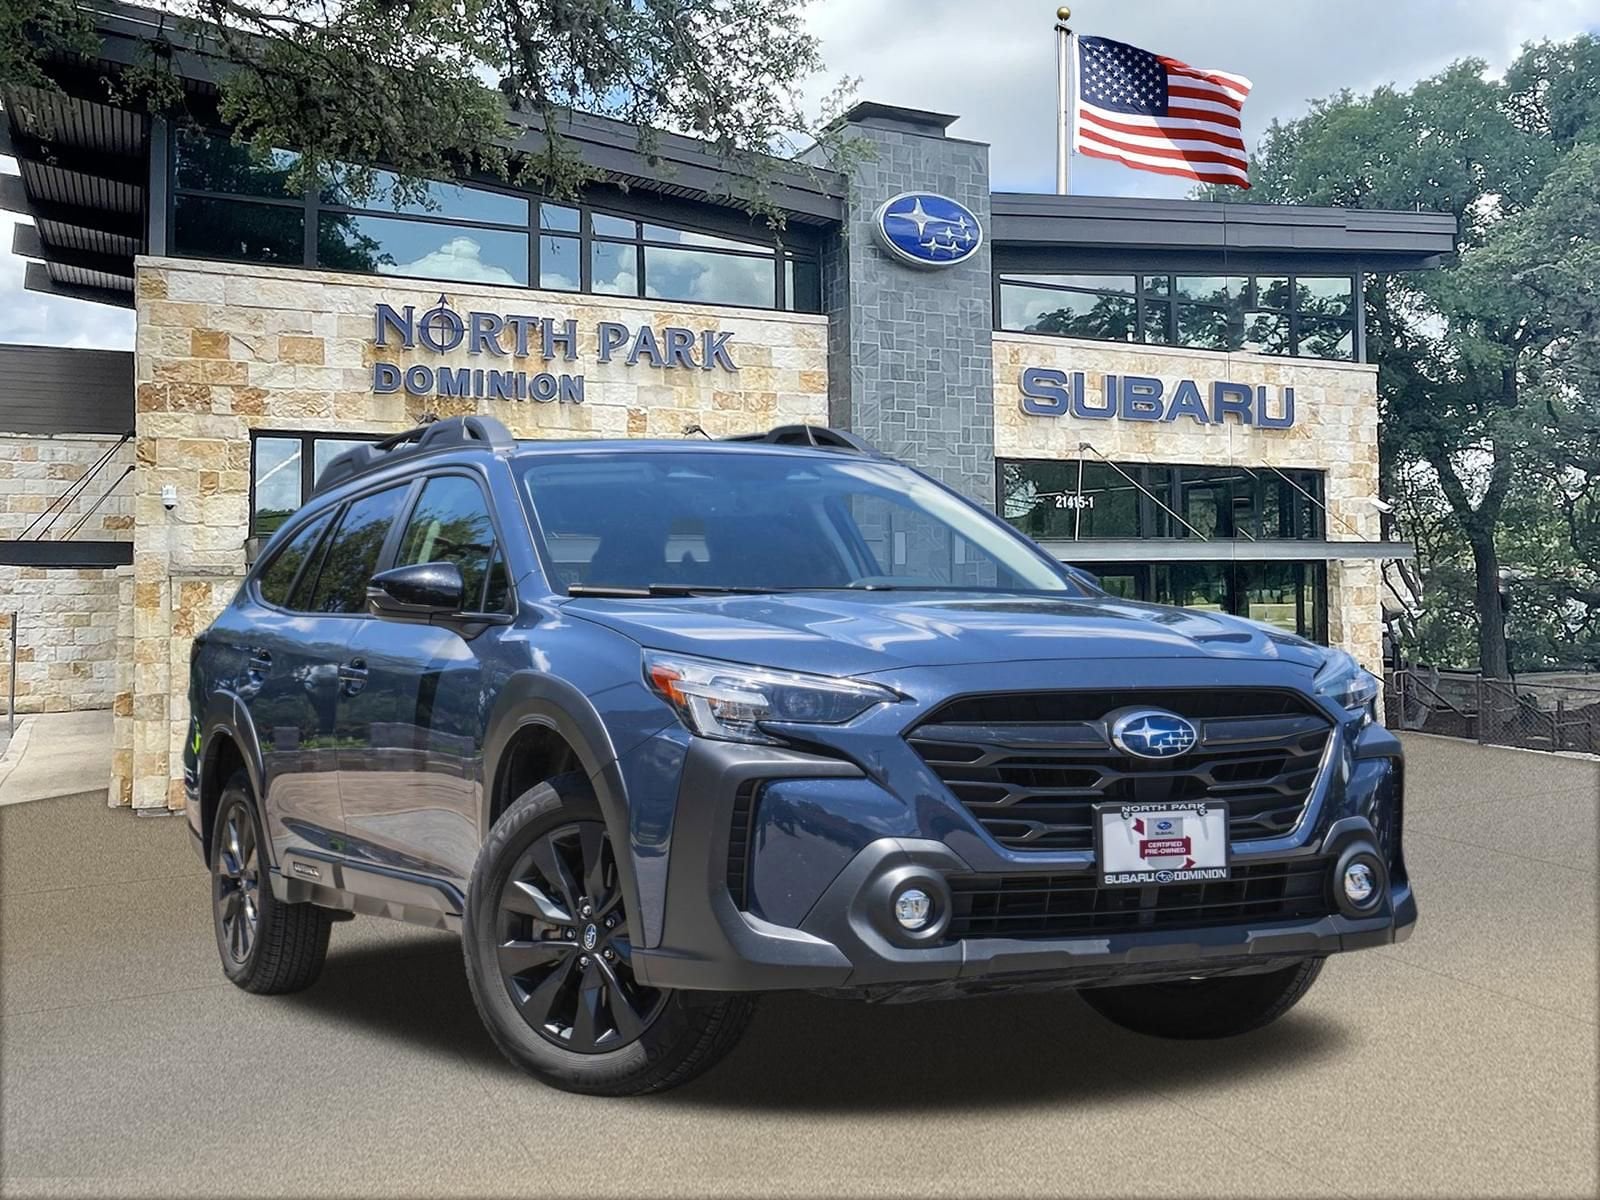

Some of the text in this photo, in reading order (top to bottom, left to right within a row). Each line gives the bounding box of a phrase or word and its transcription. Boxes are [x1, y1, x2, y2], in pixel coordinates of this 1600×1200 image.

[376, 292, 742, 373] NORTH PARK
[373, 362, 585, 404] DOMINION
[1018, 367, 1296, 429] SUBARU
[1121, 802, 1206, 812] NORTH PARK
[1144, 847, 1186, 855] PRE-OWNED
[1104, 869, 1227, 884] SUBARU DOMINION
